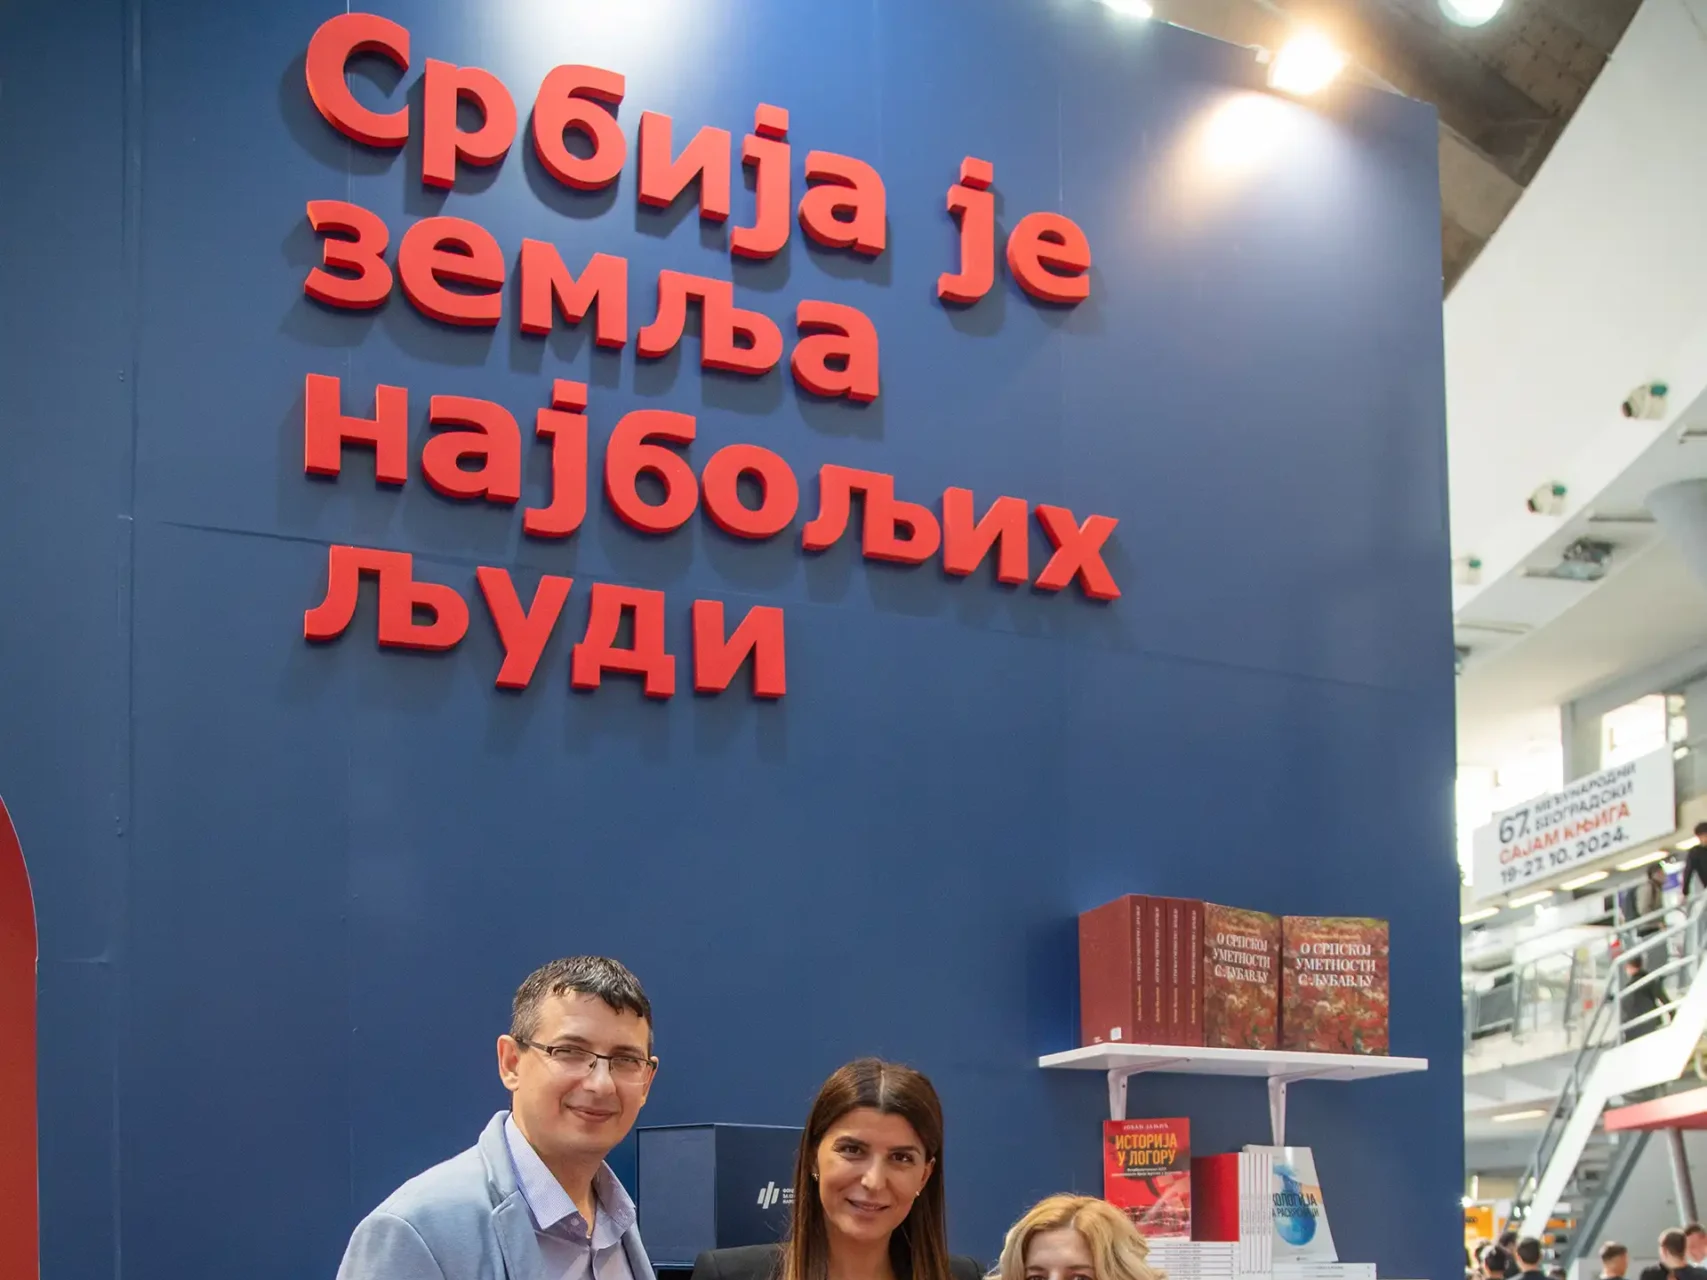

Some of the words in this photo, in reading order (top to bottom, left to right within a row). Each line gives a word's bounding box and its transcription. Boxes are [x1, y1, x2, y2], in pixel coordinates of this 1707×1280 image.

[305, 12, 887, 260] Србија
[937, 156, 1092, 305] је
[304, 200, 881, 404] земља
[304, 373, 1121, 601] најбољих
[304, 544, 787, 699] људи
[1500, 829, 1559, 865] САЈАМ
[1564, 801, 1630, 841] КЊИГА
[1216, 932, 1225, 946] О
[1226, 933, 1268, 952] СРПСКОЈ
[1301, 942, 1310, 954] О
[1313, 942, 1371, 956] СРПСКОЈ
[1213, 947, 1271, 969] УМЕТНОСТИ
[1295, 957, 1376, 972] УМЕТНОСТИ
[1309, 973, 1374, 987] ЉУБАВЉУ
[1115, 1132, 1178, 1150] ИСТОРИЈА
[1117, 1150, 1126, 1167] У
[1129, 1149, 1176, 1166] ЛОГОРУ
